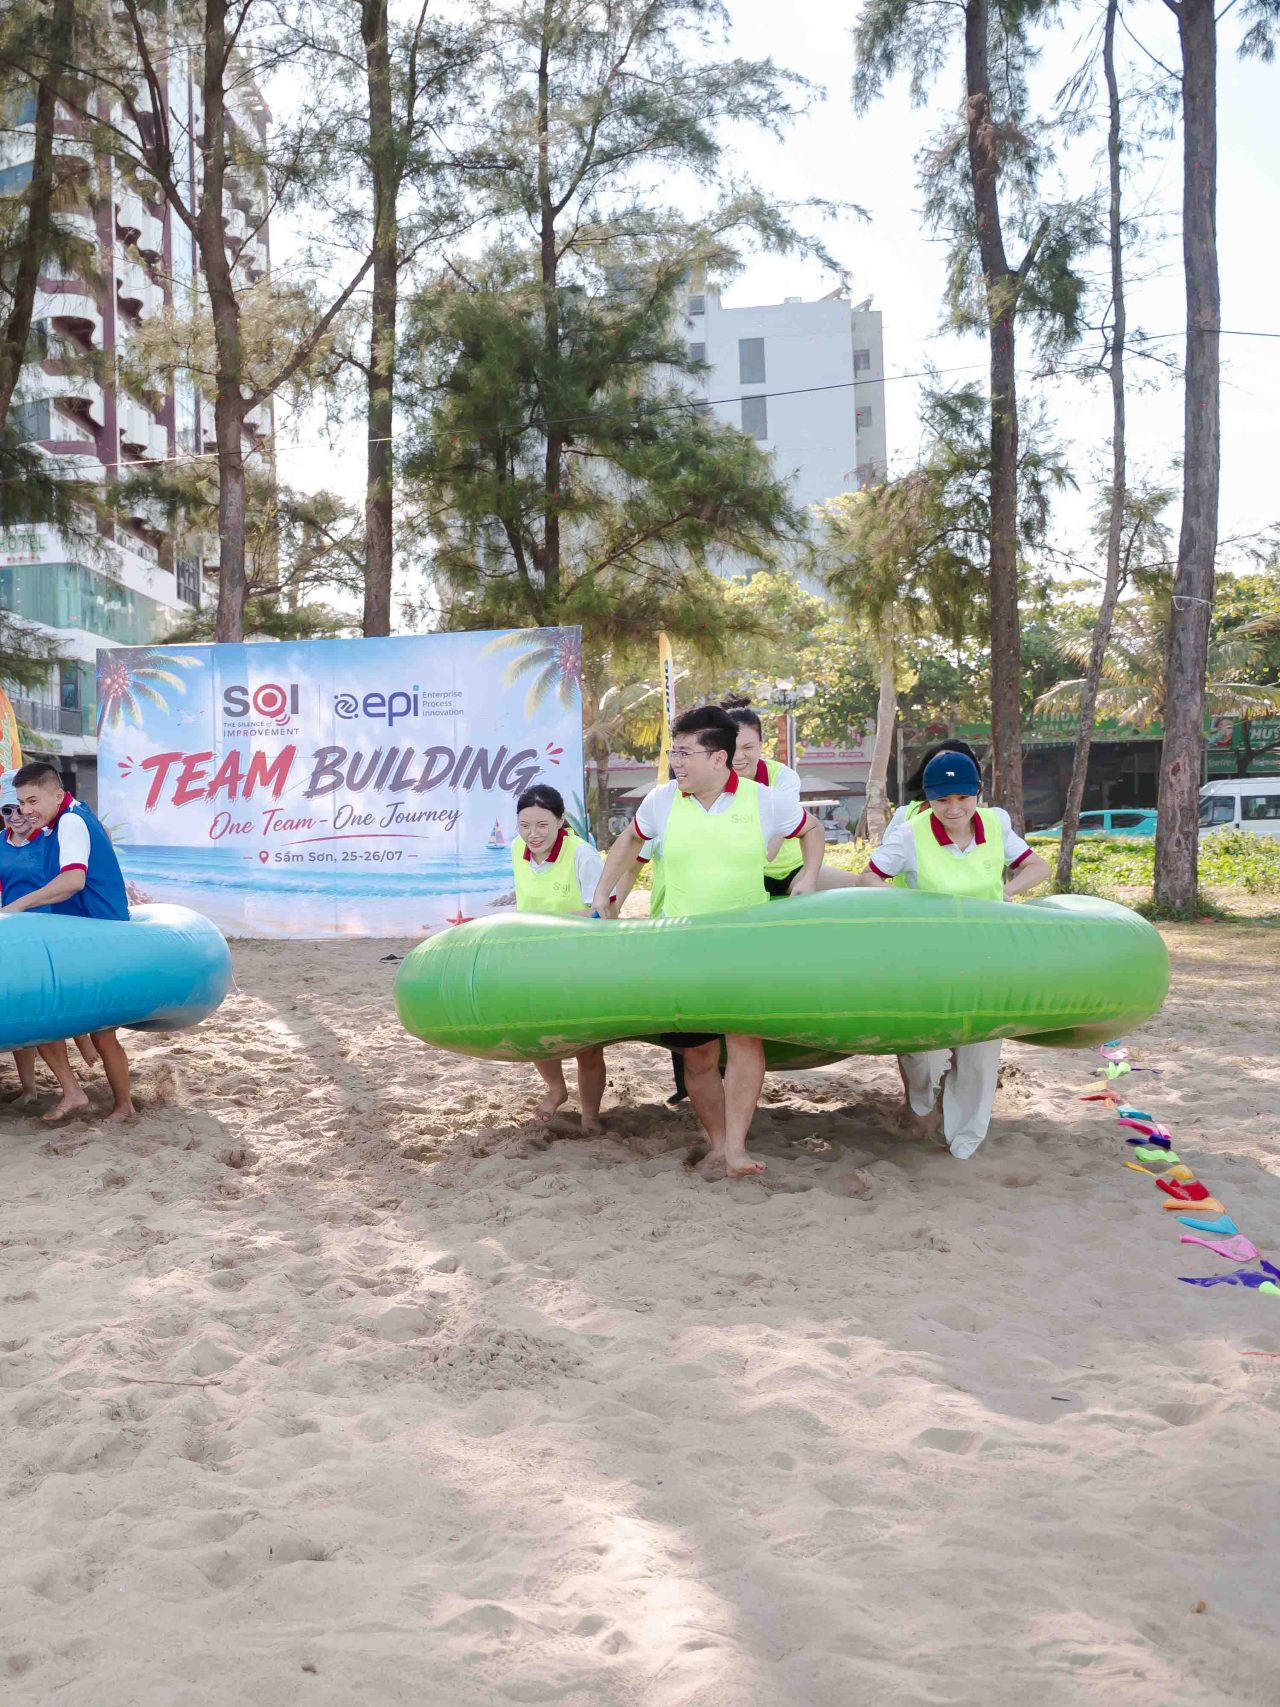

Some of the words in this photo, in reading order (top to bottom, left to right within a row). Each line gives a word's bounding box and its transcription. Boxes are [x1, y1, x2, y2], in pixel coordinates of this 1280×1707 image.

[422, 690, 463, 699] Enterprise
[362, 684, 420, 727] epi
[422, 700, 453, 708] Process
[422, 708, 465, 717] Innovation
[223, 728, 300, 737] IMPROVEMENT
[138, 744, 297, 813] TEAM
[301, 744, 545, 799] BUILDING
[208, 811, 254, 840] One
[262, 808, 316, 836] Team
[333, 804, 376, 830] One
[379, 801, 464, 831] Journey
[308, 851, 337, 863] Sơn,
[341, 850, 403, 863] 25-26/07
